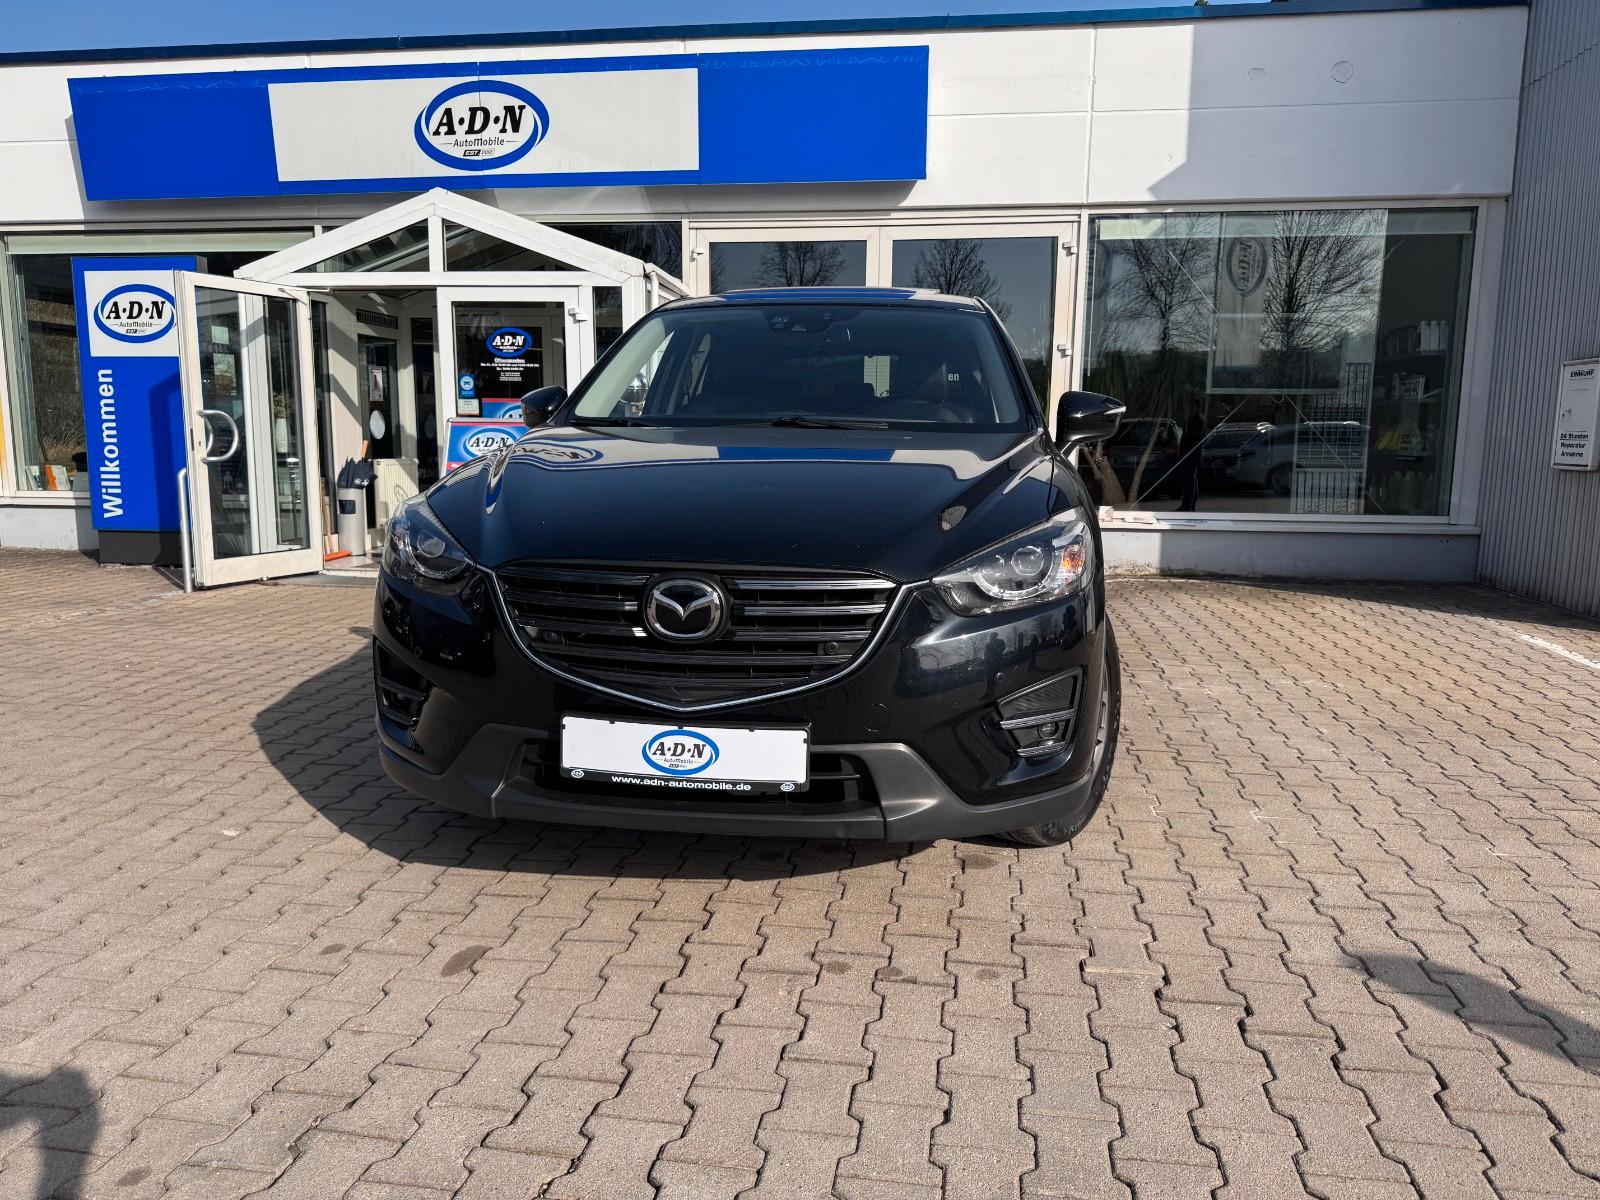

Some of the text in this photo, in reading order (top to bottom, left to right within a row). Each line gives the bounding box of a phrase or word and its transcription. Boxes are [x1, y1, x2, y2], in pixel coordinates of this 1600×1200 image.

[453, 136, 505, 147] AutoMobile
[1568, 432, 1589, 440] Stunden
[97, 368, 124, 519] Willkommen
[1560, 441, 1587, 449] Reparatur
[611, 775, 752, 791] www.adn-automobile.de
